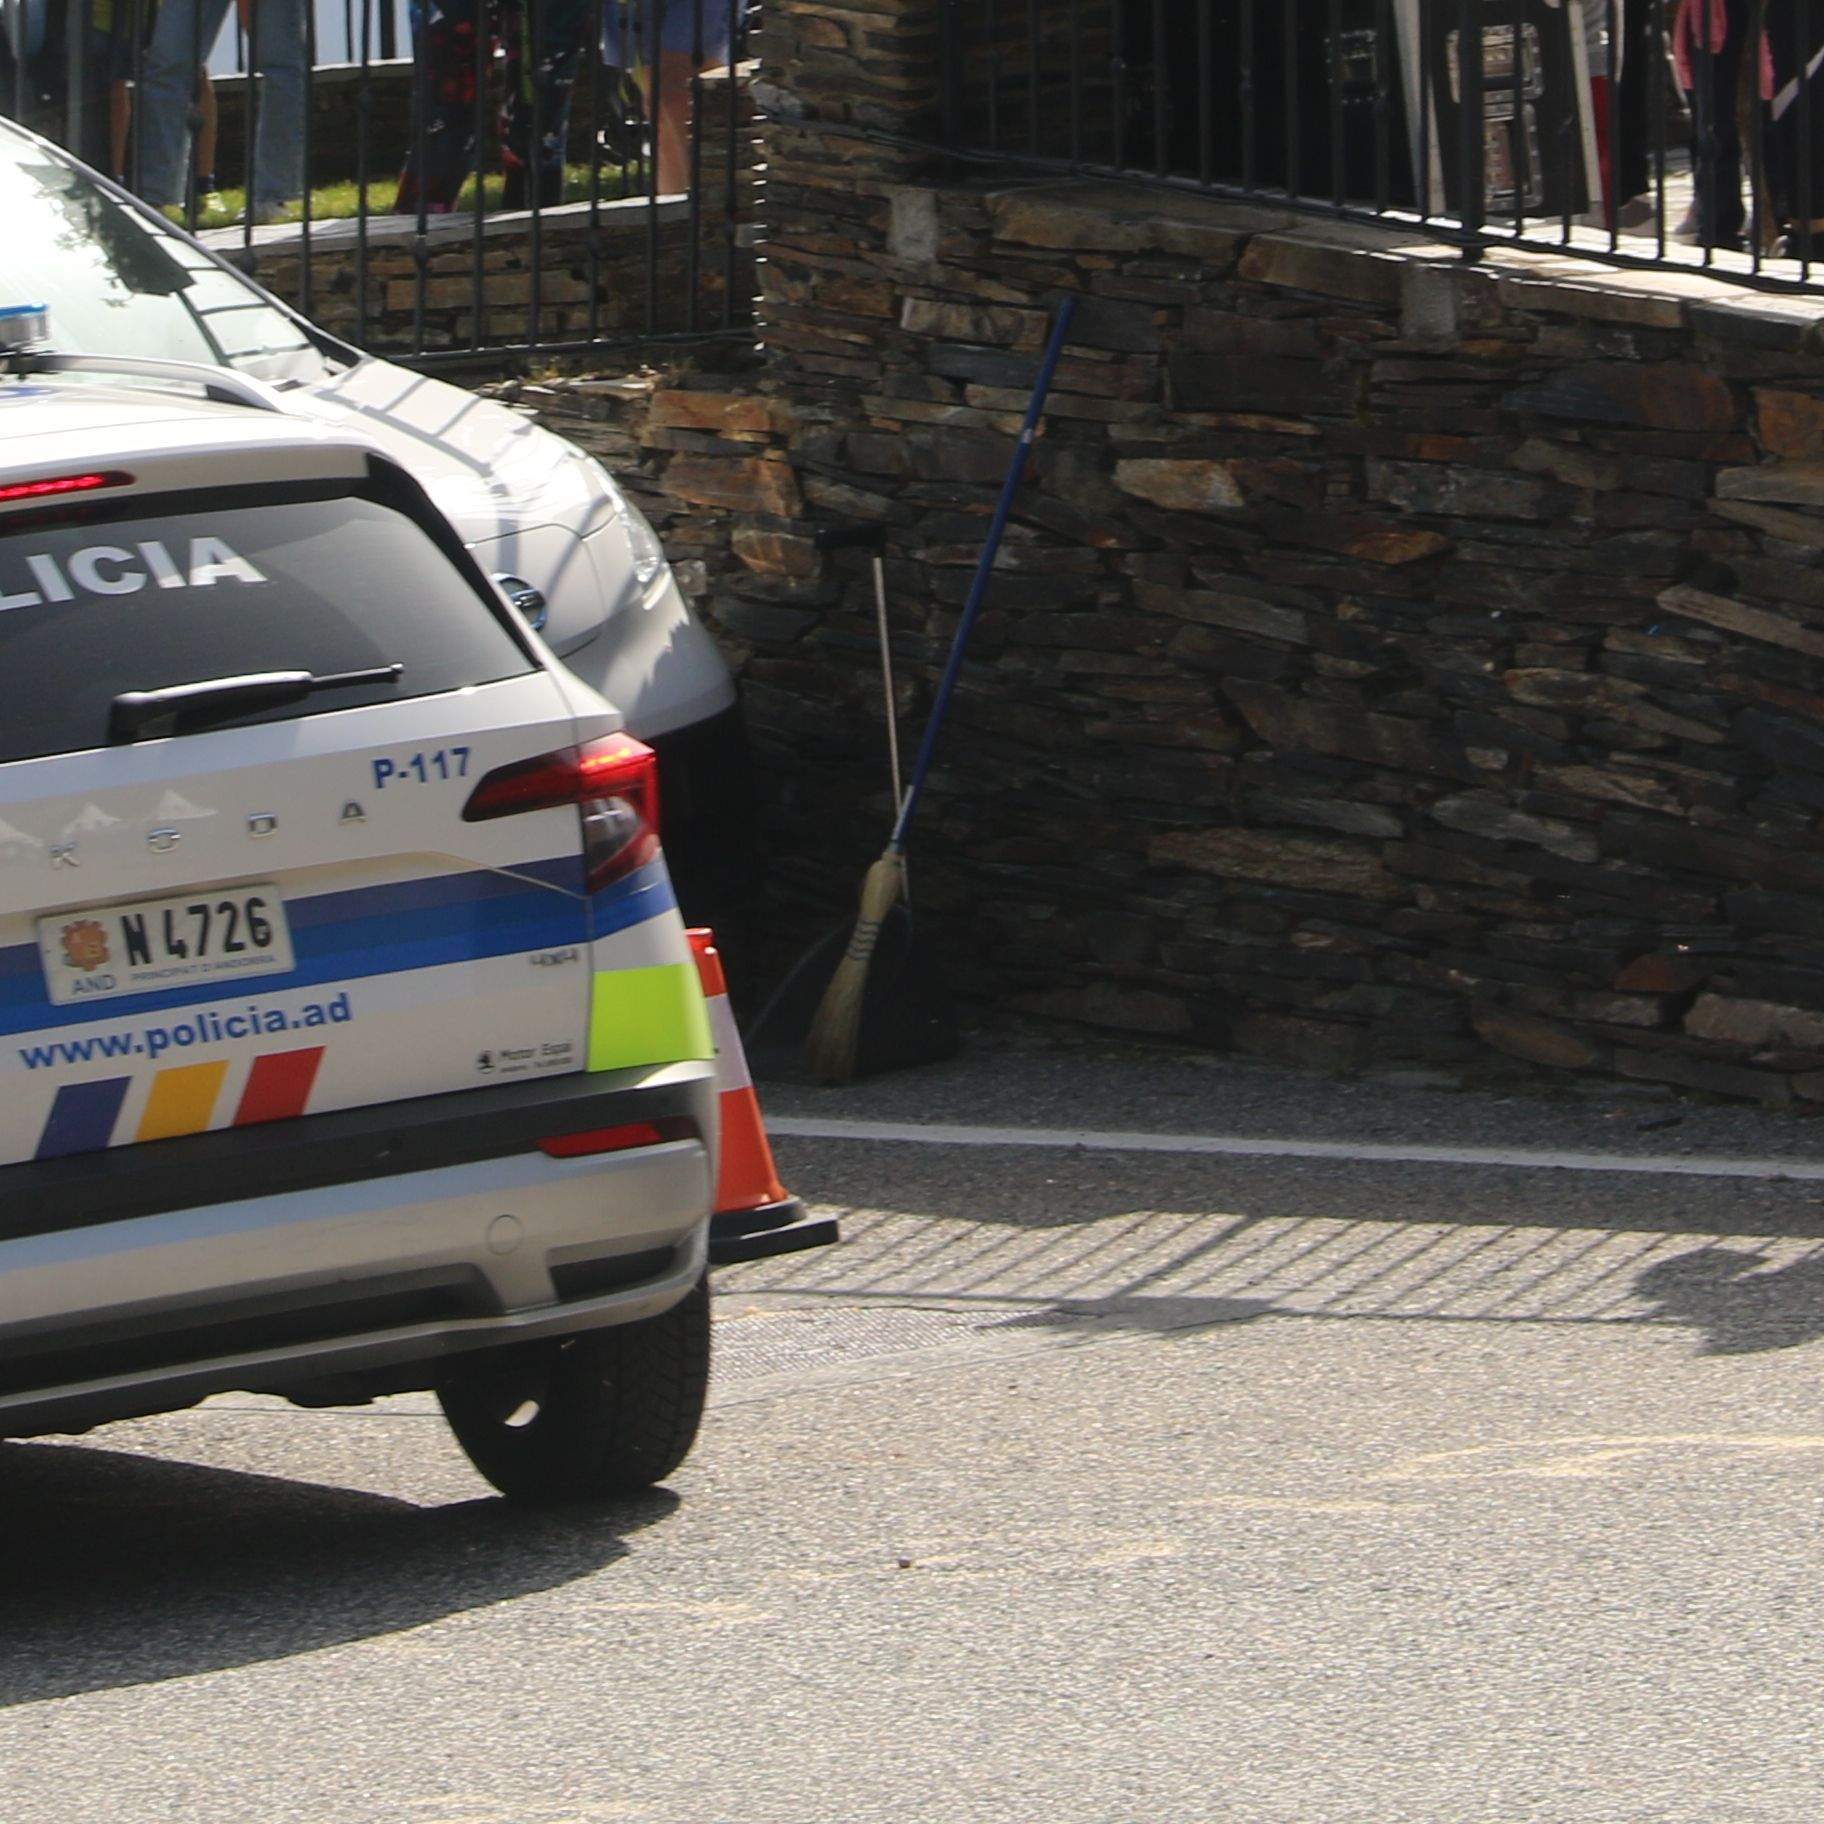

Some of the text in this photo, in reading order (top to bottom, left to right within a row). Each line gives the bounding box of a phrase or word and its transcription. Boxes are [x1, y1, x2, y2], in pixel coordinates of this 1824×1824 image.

[371, 746, 472, 789] P-117
[72, 975, 116, 995] AND
[19, 991, 353, 1070] www.policia.ad
